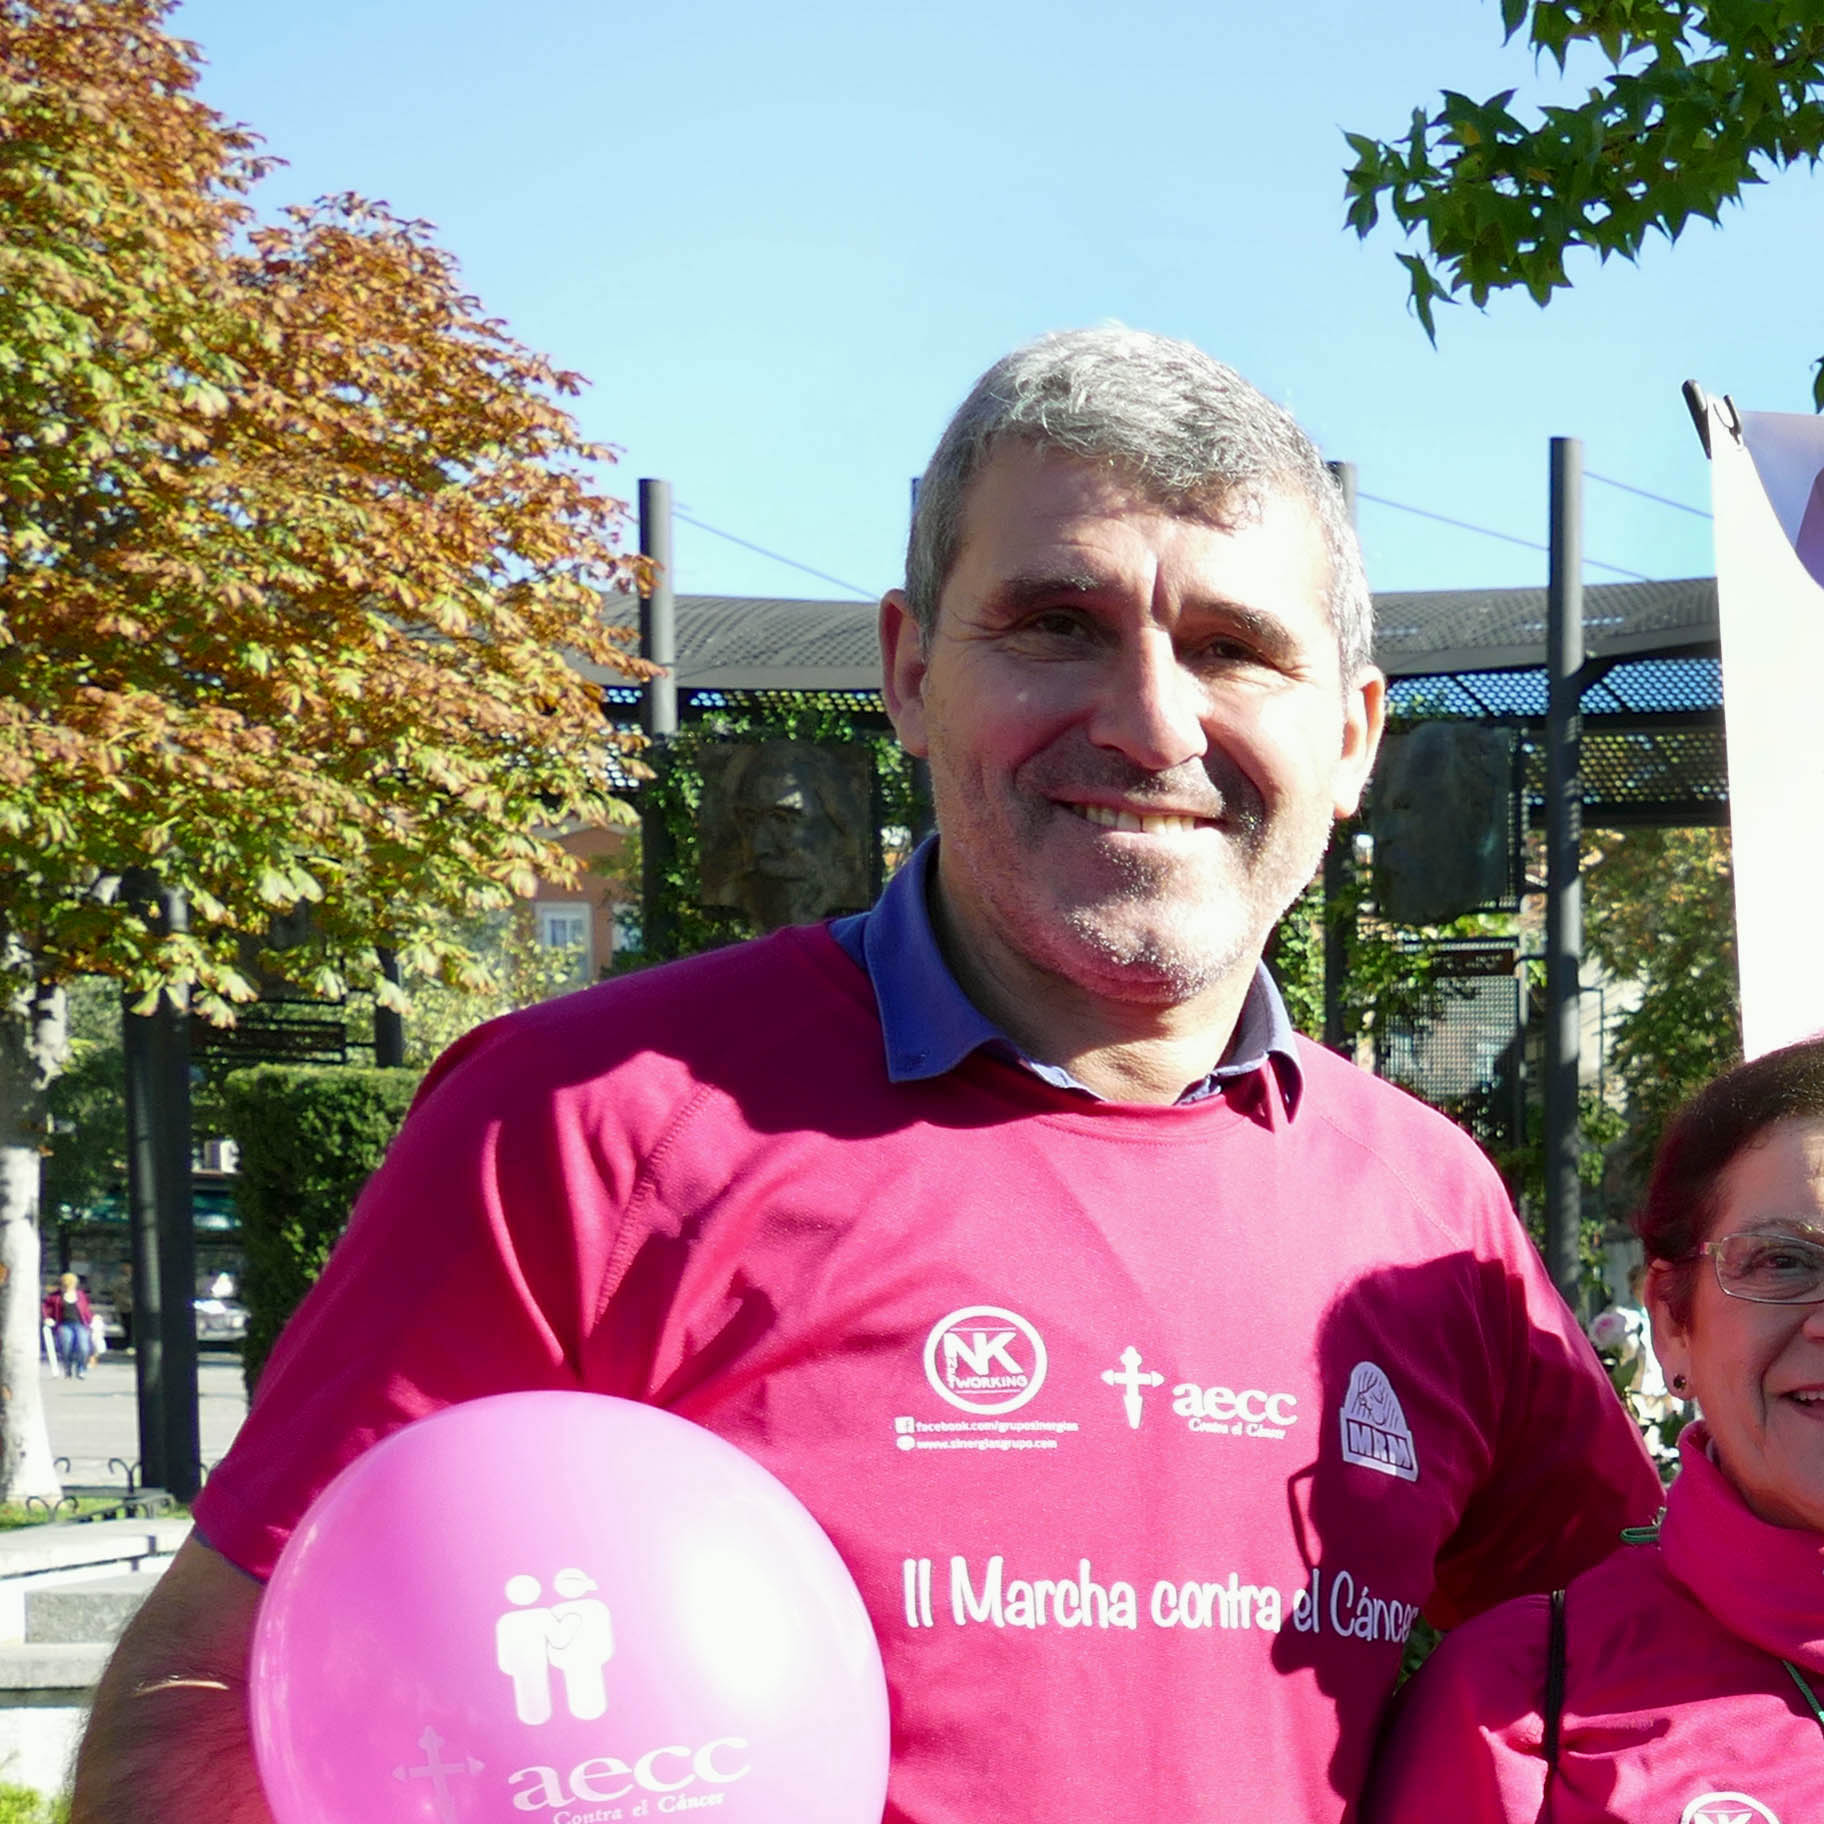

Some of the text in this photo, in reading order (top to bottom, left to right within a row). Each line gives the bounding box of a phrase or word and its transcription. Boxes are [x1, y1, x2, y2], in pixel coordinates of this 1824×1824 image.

[943, 1331, 1025, 1376] NK
[1172, 1382, 1299, 1426] aecc
[1349, 1420, 1413, 1471] MRM
[903, 1554, 1321, 1634] II Marcha contra el
[507, 1736, 752, 1812] aecc
[632, 1800, 650, 1818] el
[657, 1789, 728, 1815] Cáncer
